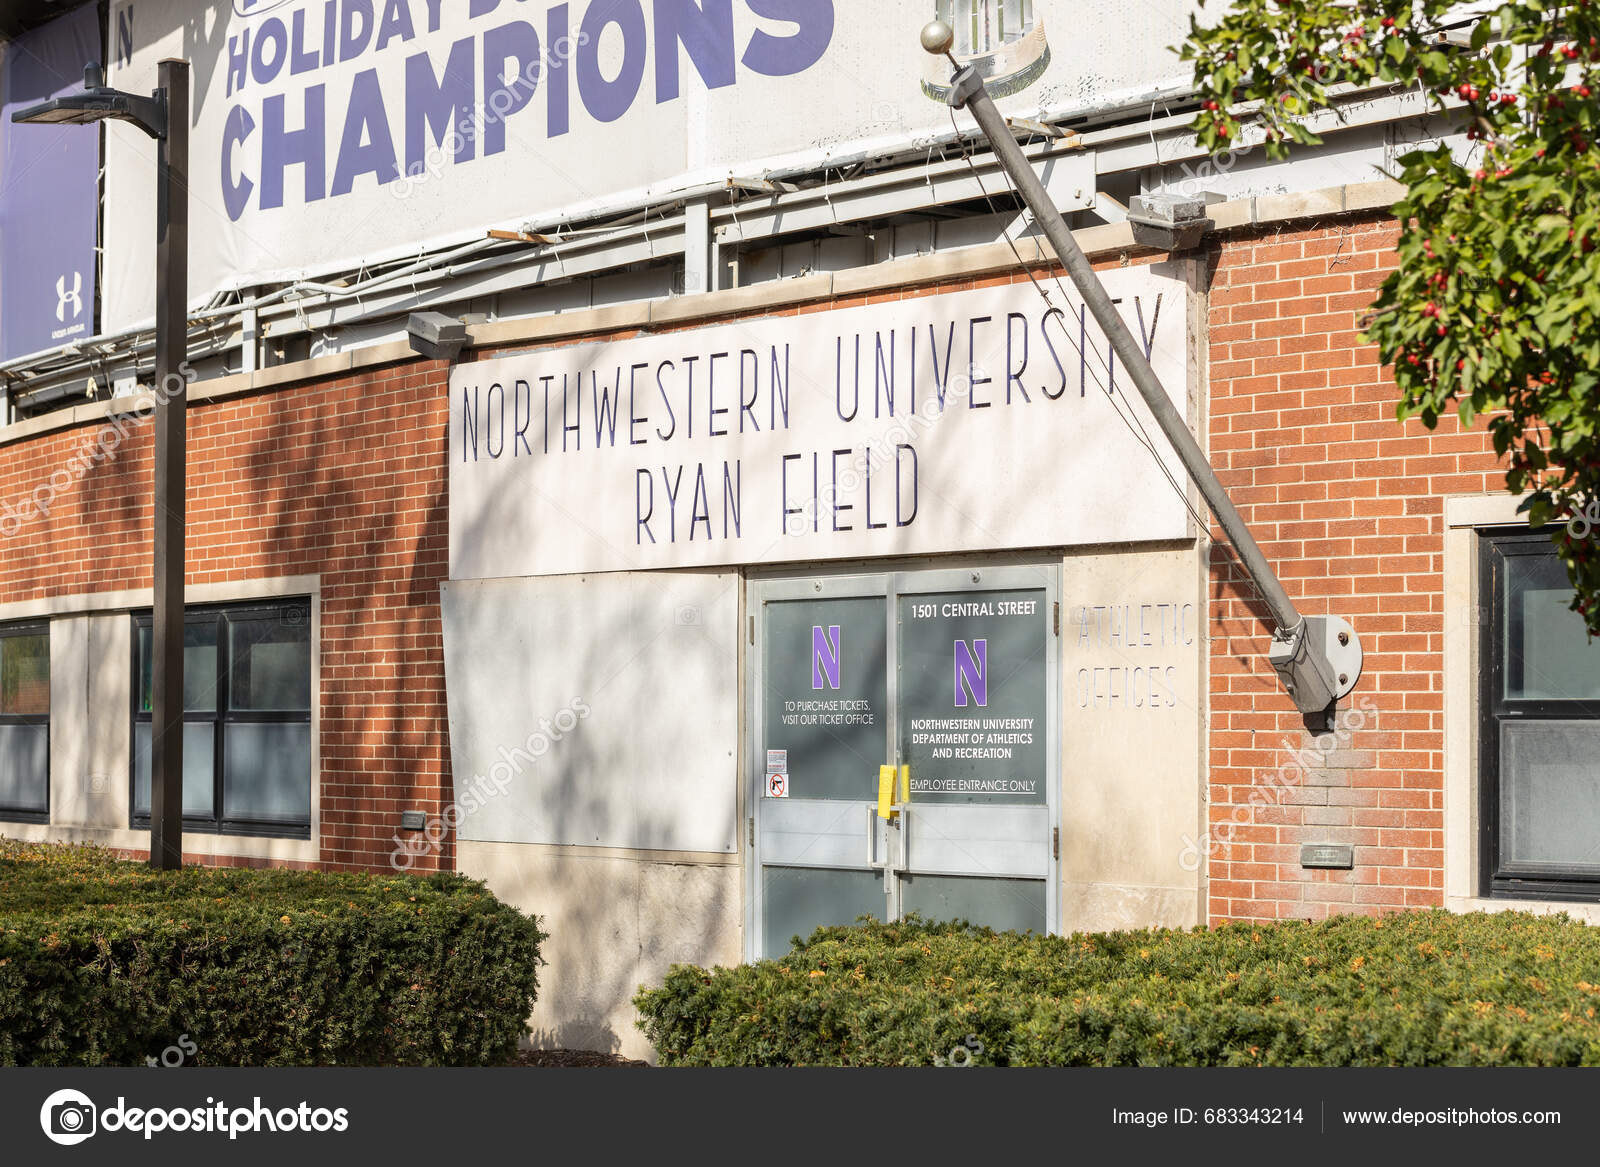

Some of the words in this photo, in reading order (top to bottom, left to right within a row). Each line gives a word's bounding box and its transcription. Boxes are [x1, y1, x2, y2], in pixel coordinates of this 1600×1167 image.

[117, 4, 134, 71] N
[220, 0, 836, 222] CHAMPIONS
[463, 343, 790, 462] NORTHWESTERN
[836, 292, 1163, 423] UNIVERSITY
[636, 459, 741, 545] RYAN
[782, 443, 918, 535] FIELD
[912, 604, 938, 618] 1501
[941, 602, 995, 617] CENTRAL
[997, 600, 1037, 616] STREET
[1077, 603, 1193, 649] ATHLETIC
[812, 625, 841, 690] N
[954, 638, 988, 707] N
[784, 701, 796, 712] TO
[797, 700, 838, 712] PURCHASE
[1077, 665, 1177, 709] OFFICES
[782, 714, 798, 725] VISIT
[799, 714, 818, 725] OUR
[819, 714, 844, 725] TICKET
[845, 713, 874, 725] OFFICE
[911, 719, 980, 730] NORTHWESTERN
[983, 718, 1034, 730] UNIVERSITY
[912, 733, 968, 744] DEPARTMENT
[971, 733, 984, 744] OF
[986, 733, 1033, 744] ATHLETICS
[932, 748, 952, 758] AND
[955, 748, 1012, 758] RECREATION
[910, 779, 956, 791] EMPLOYEE
[958, 779, 1010, 792] ENTRANCE
[1009, 780, 1036, 792] ONLY
